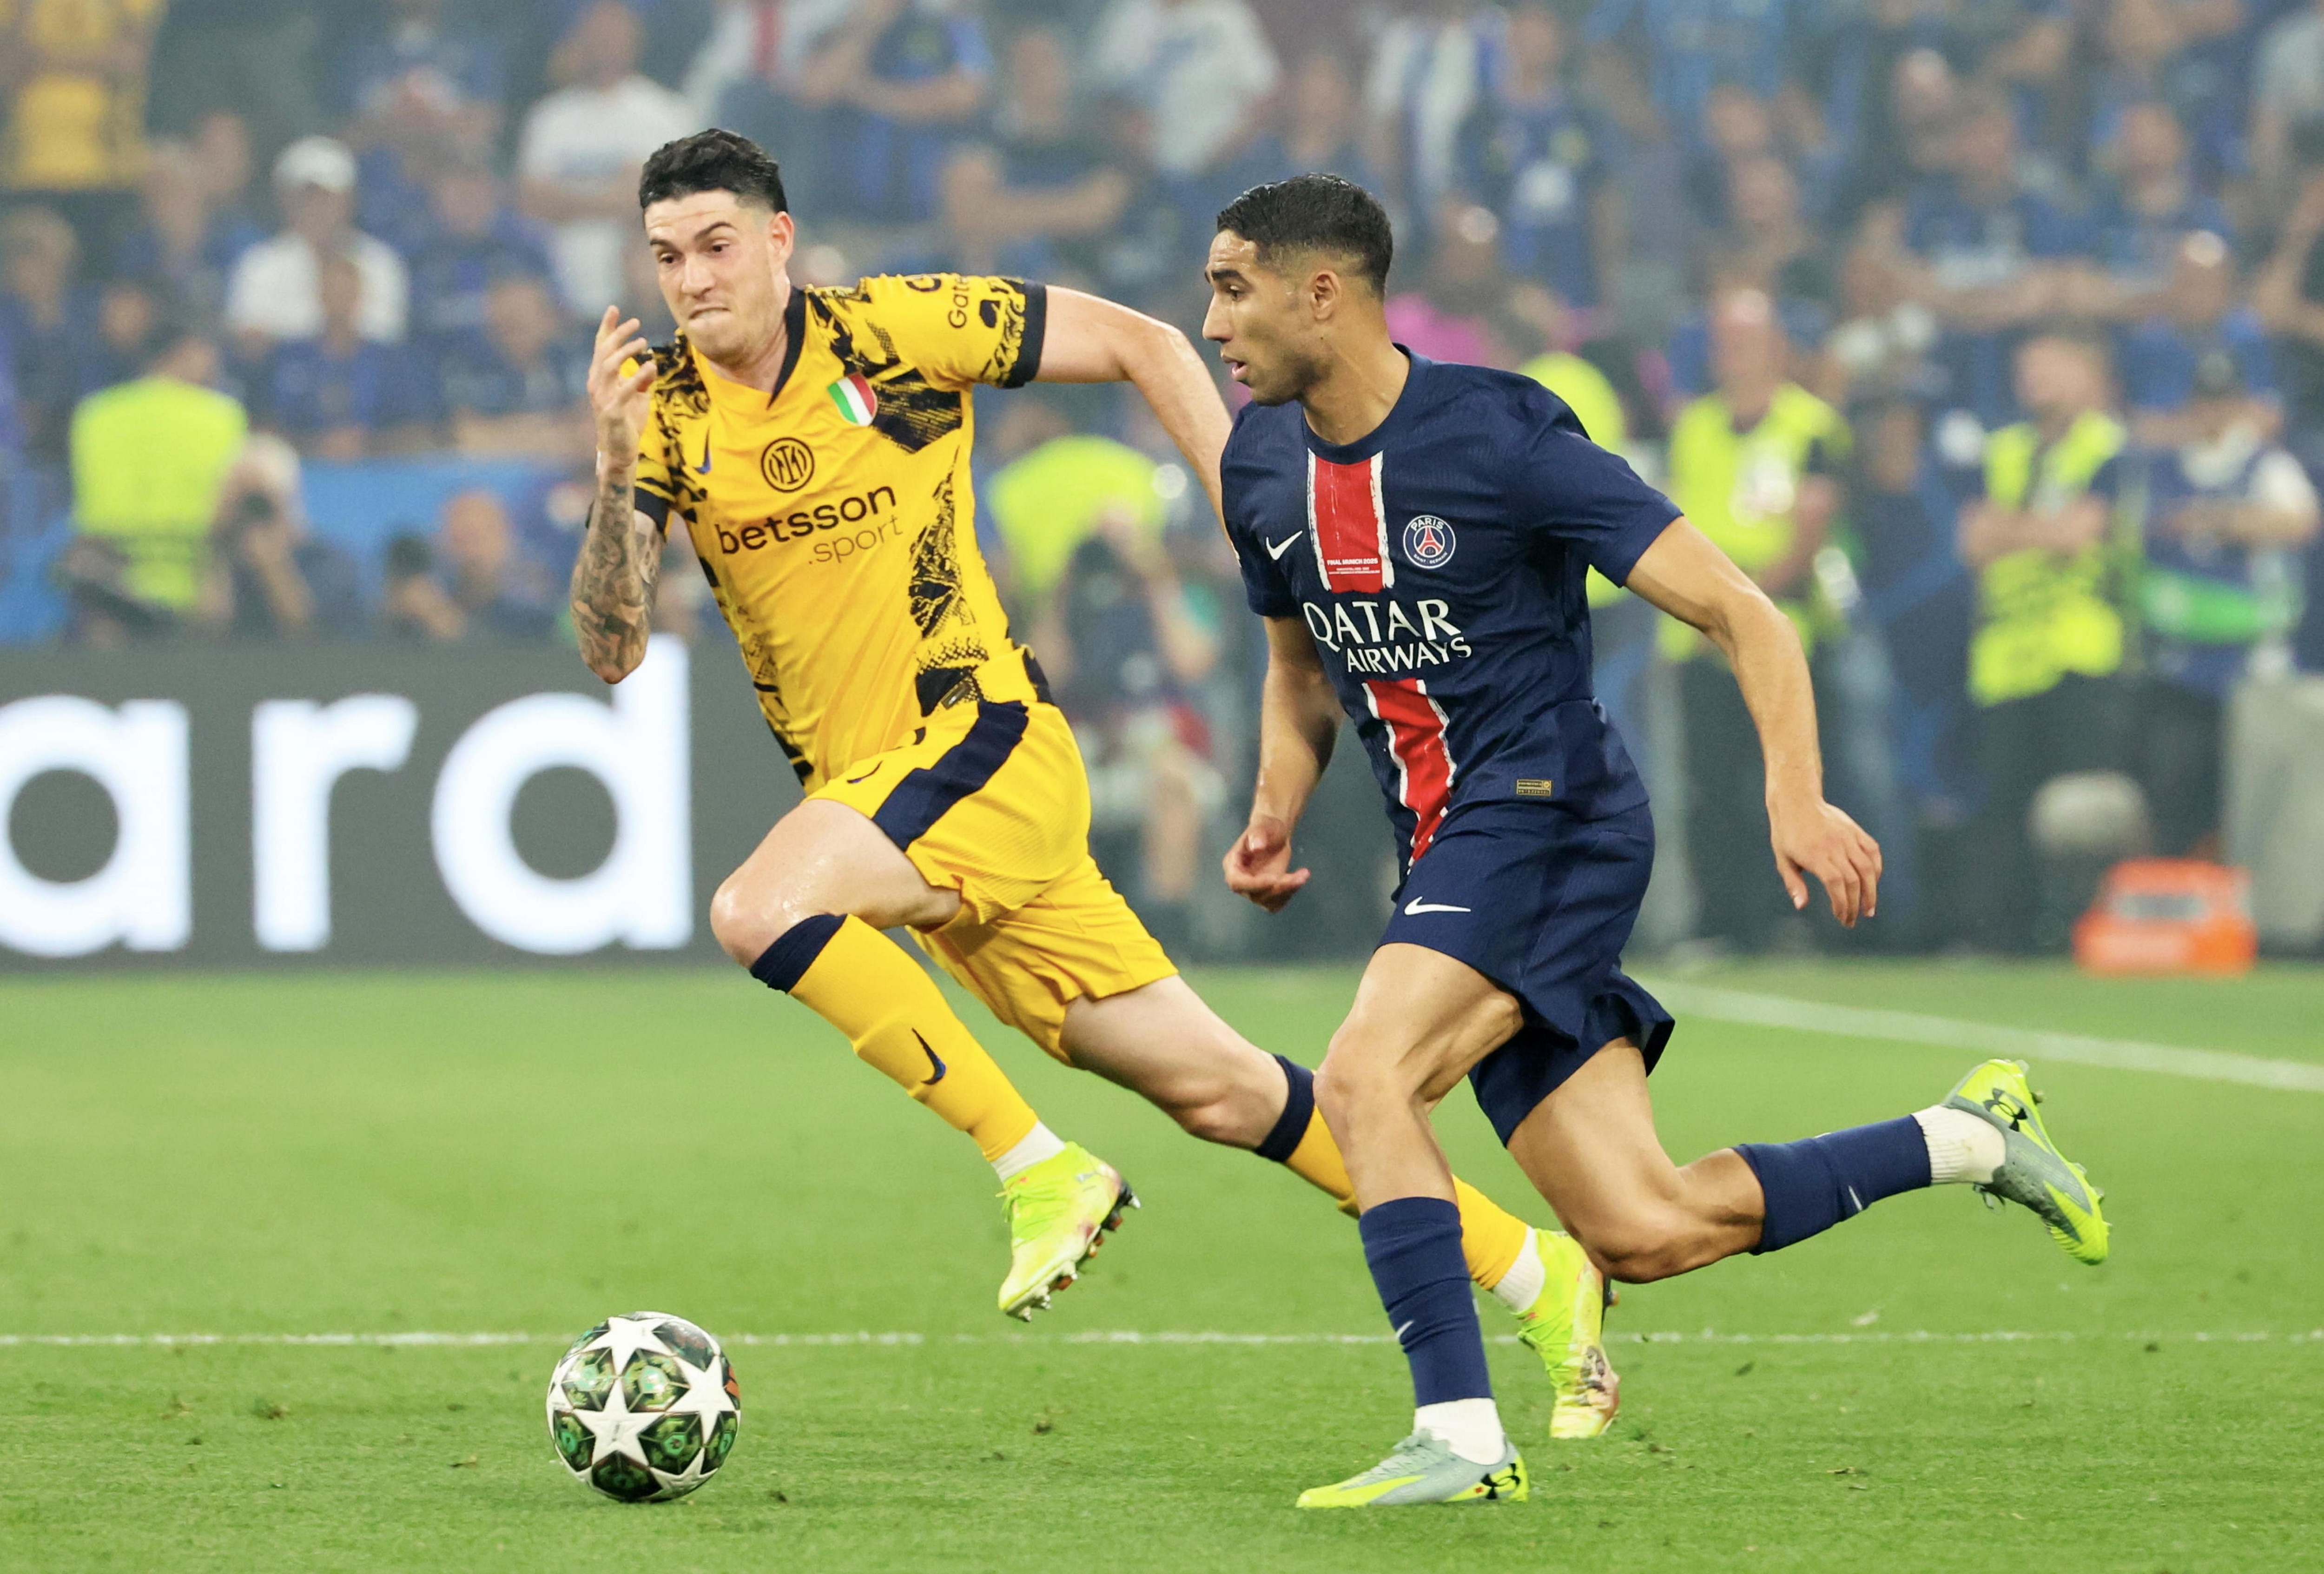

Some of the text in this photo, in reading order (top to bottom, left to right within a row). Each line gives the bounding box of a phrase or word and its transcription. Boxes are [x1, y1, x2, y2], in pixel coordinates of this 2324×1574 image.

[714, 485, 896, 554] betsson
[808, 515, 903, 564] .sport
[1411, 517, 1444, 531] PARIS
[1303, 599, 1461, 651] QATAR
[1347, 636, 1472, 673] AIRWAYS
[0, 631, 691, 956] ard
